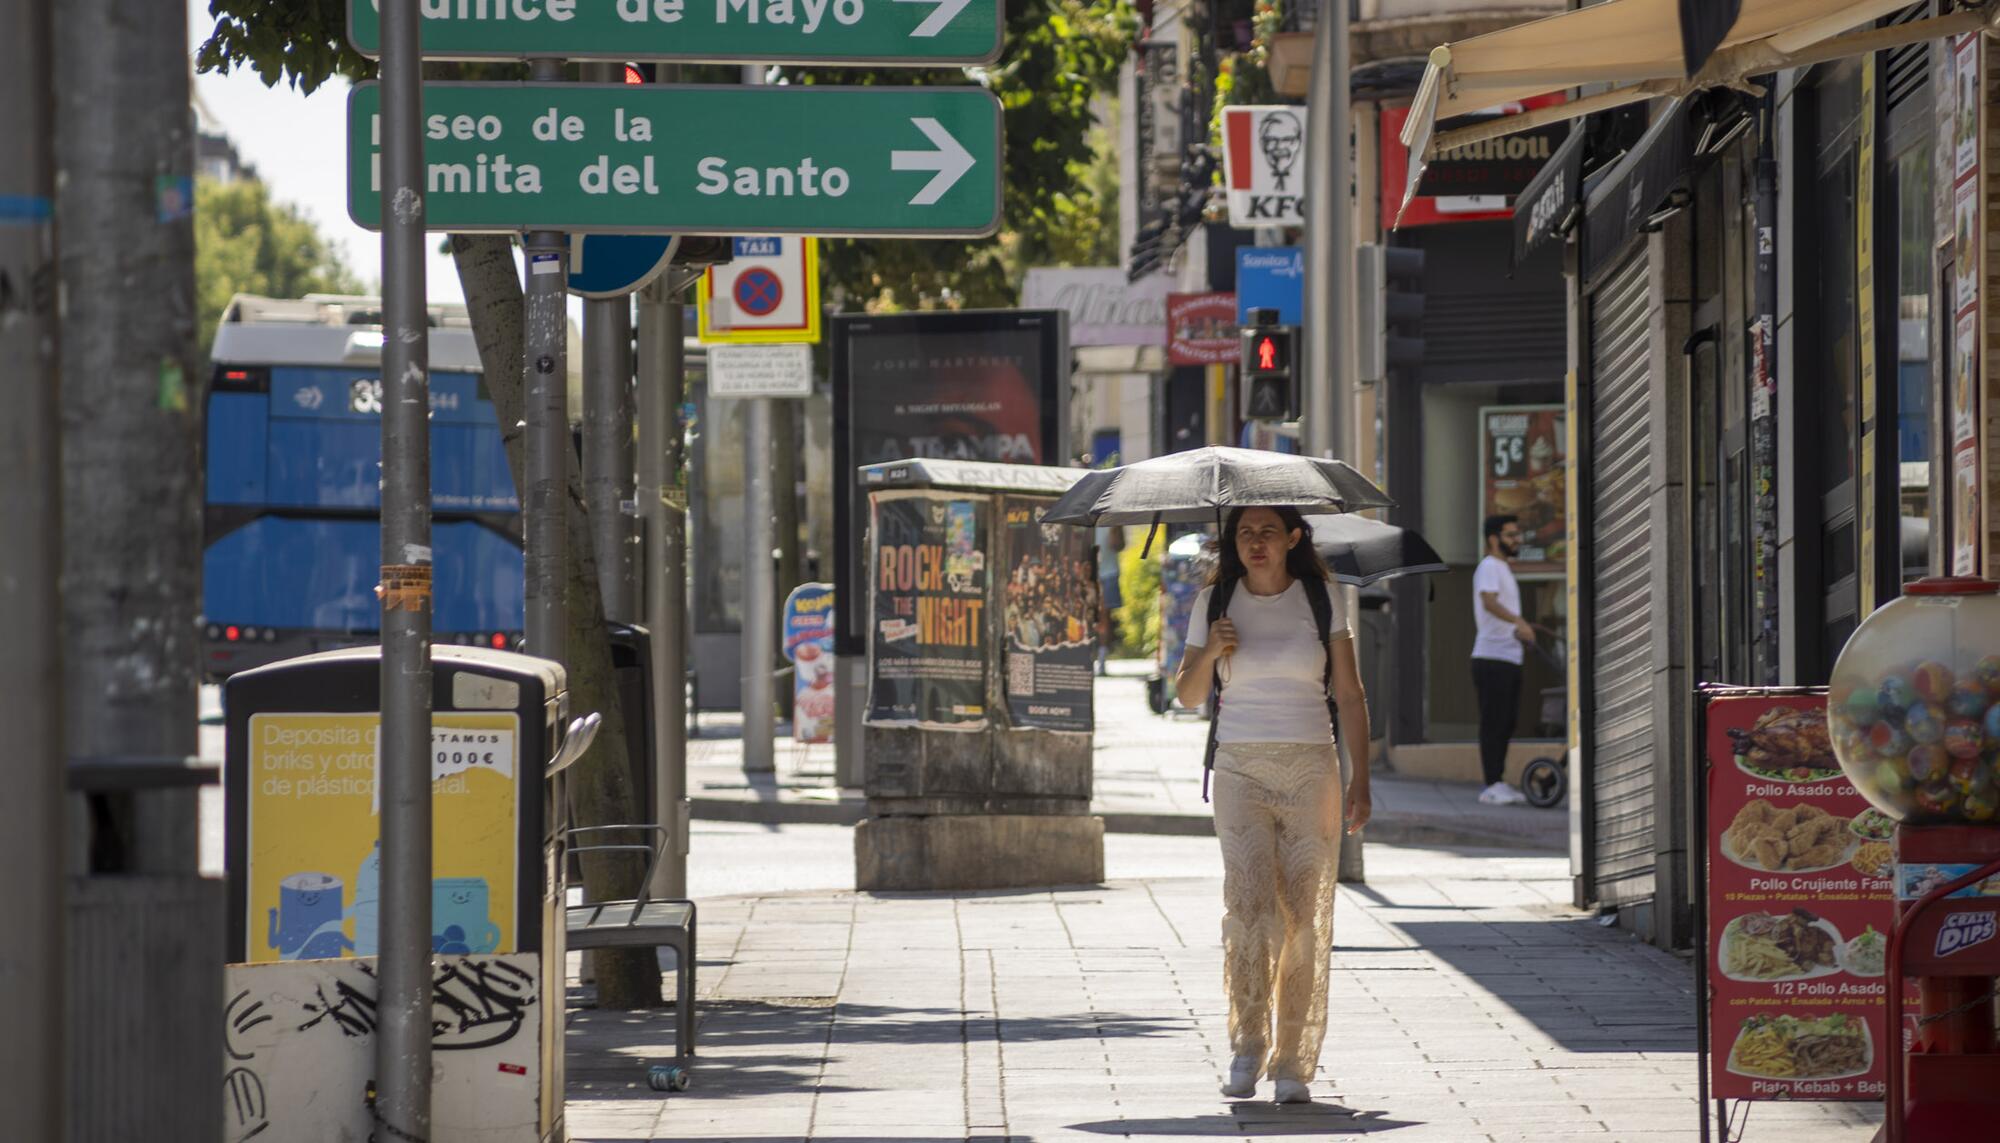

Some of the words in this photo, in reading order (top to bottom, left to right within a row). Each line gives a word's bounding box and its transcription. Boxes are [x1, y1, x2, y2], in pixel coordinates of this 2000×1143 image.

[371, 0, 576, 21] uince
[616, 0, 684, 22] de
[715, 0, 864, 34] Mayo
[371, 113, 502, 145] seo
[532, 107, 585, 141] de
[614, 107, 653, 142] la
[371, 153, 542, 194] mita
[579, 155, 659, 195] del
[696, 156, 849, 197] Santo
[739, 240, 776, 254] TAXI
[880, 544, 943, 591] ROCK
[915, 596, 983, 647] NIGHT
[263, 723, 360, 748] Deposita
[263, 750, 314, 770] briks
[320, 753, 333, 772] y
[263, 775, 292, 795] de
[1746, 784, 1783, 796] Pollo
[1787, 784, 1833, 796] Asado
[1751, 878, 1788, 890] Pollo
[1791, 877, 1857, 893] Crujiente
[1946, 913, 1994, 927] CRAZY
[1939, 922, 1994, 954] DIPS
[1773, 983, 1793, 994] 1/2
[1798, 982, 1835, 995] Pollo
[1838, 982, 1886, 995] Asado
[1752, 1081, 1789, 1093] Plato
[1794, 1081, 1840, 1093] Kebab
